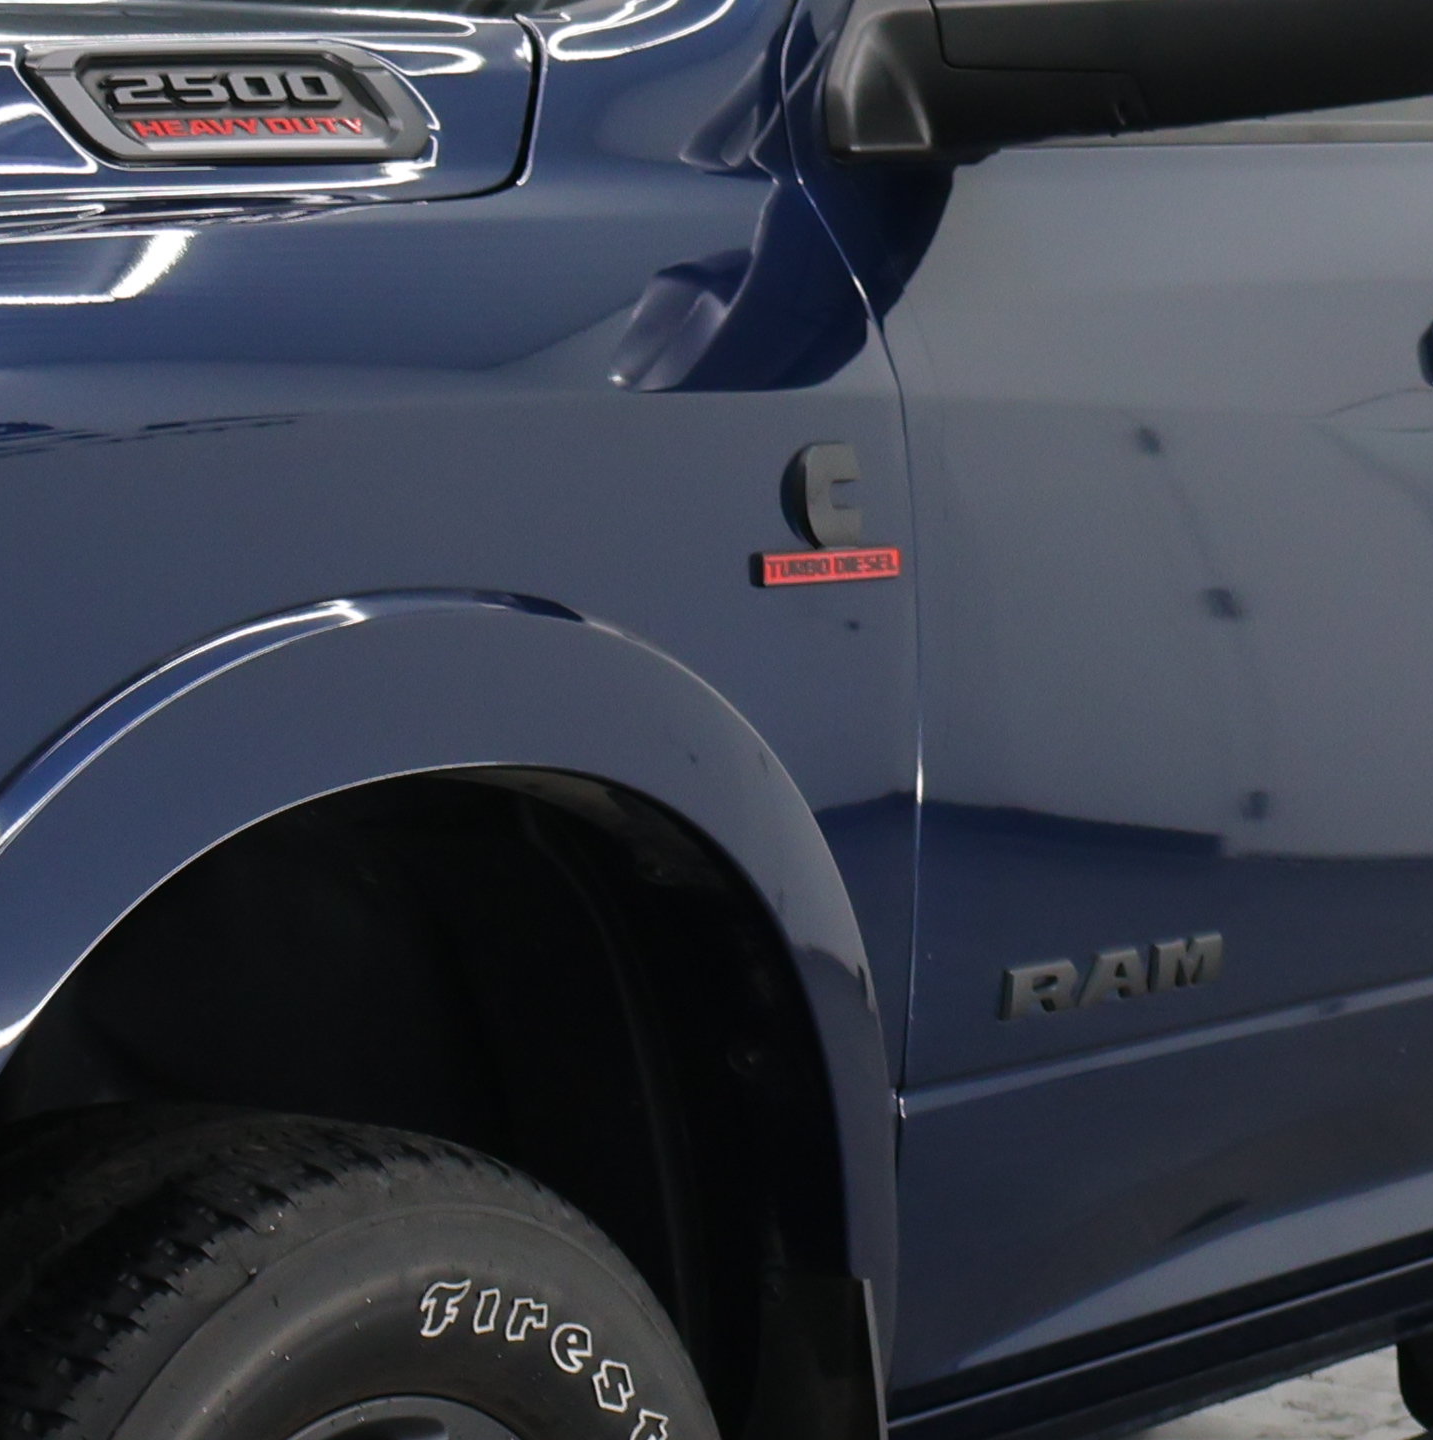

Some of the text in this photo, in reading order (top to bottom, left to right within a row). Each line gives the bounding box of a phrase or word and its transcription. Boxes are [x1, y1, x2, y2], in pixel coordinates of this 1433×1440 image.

[109, 71, 343, 108] 2500
[133, 117, 363, 138] HEAVY DUTY
[766, 553, 898, 579] TURBO DIESEL
[998, 931, 1224, 1022] RAM
